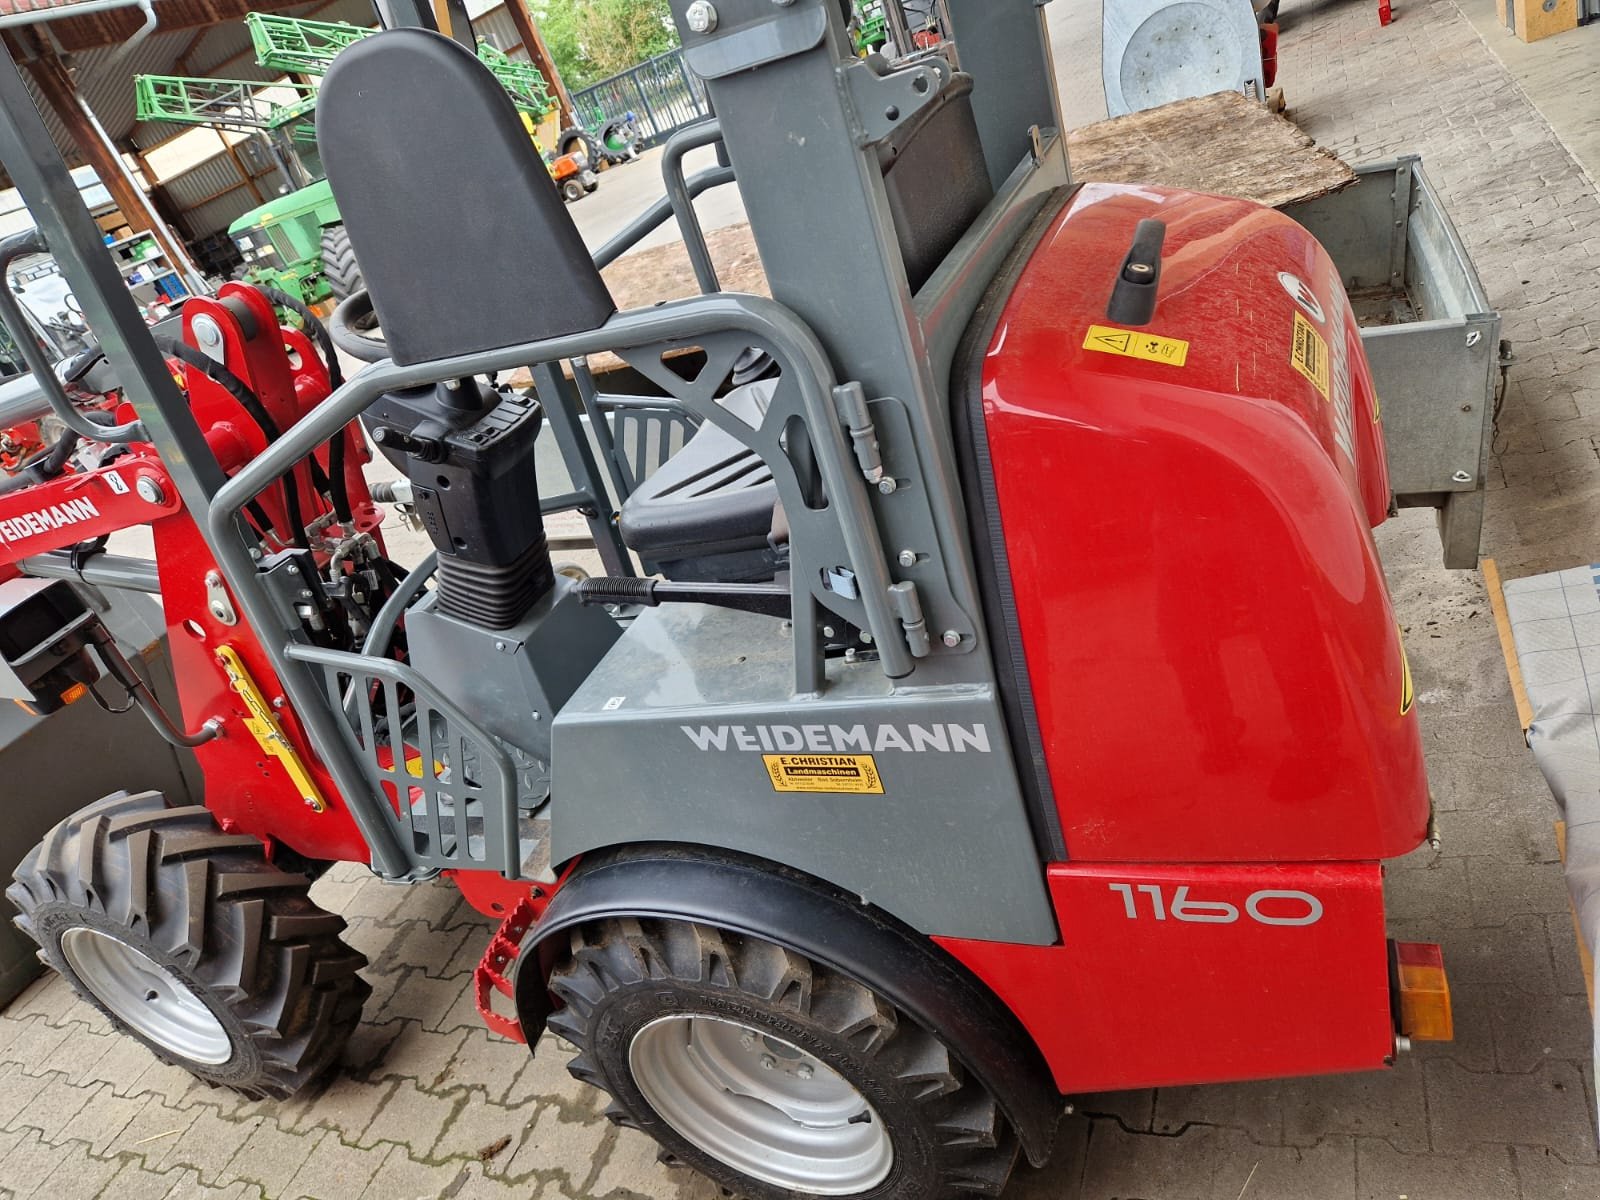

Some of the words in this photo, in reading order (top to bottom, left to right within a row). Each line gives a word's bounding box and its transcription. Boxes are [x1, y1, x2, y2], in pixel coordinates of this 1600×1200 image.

[0, 496, 100, 543] EIDEMANN
[680, 723, 991, 752] WEIDEMANN
[1108, 883, 1323, 926] 1160
